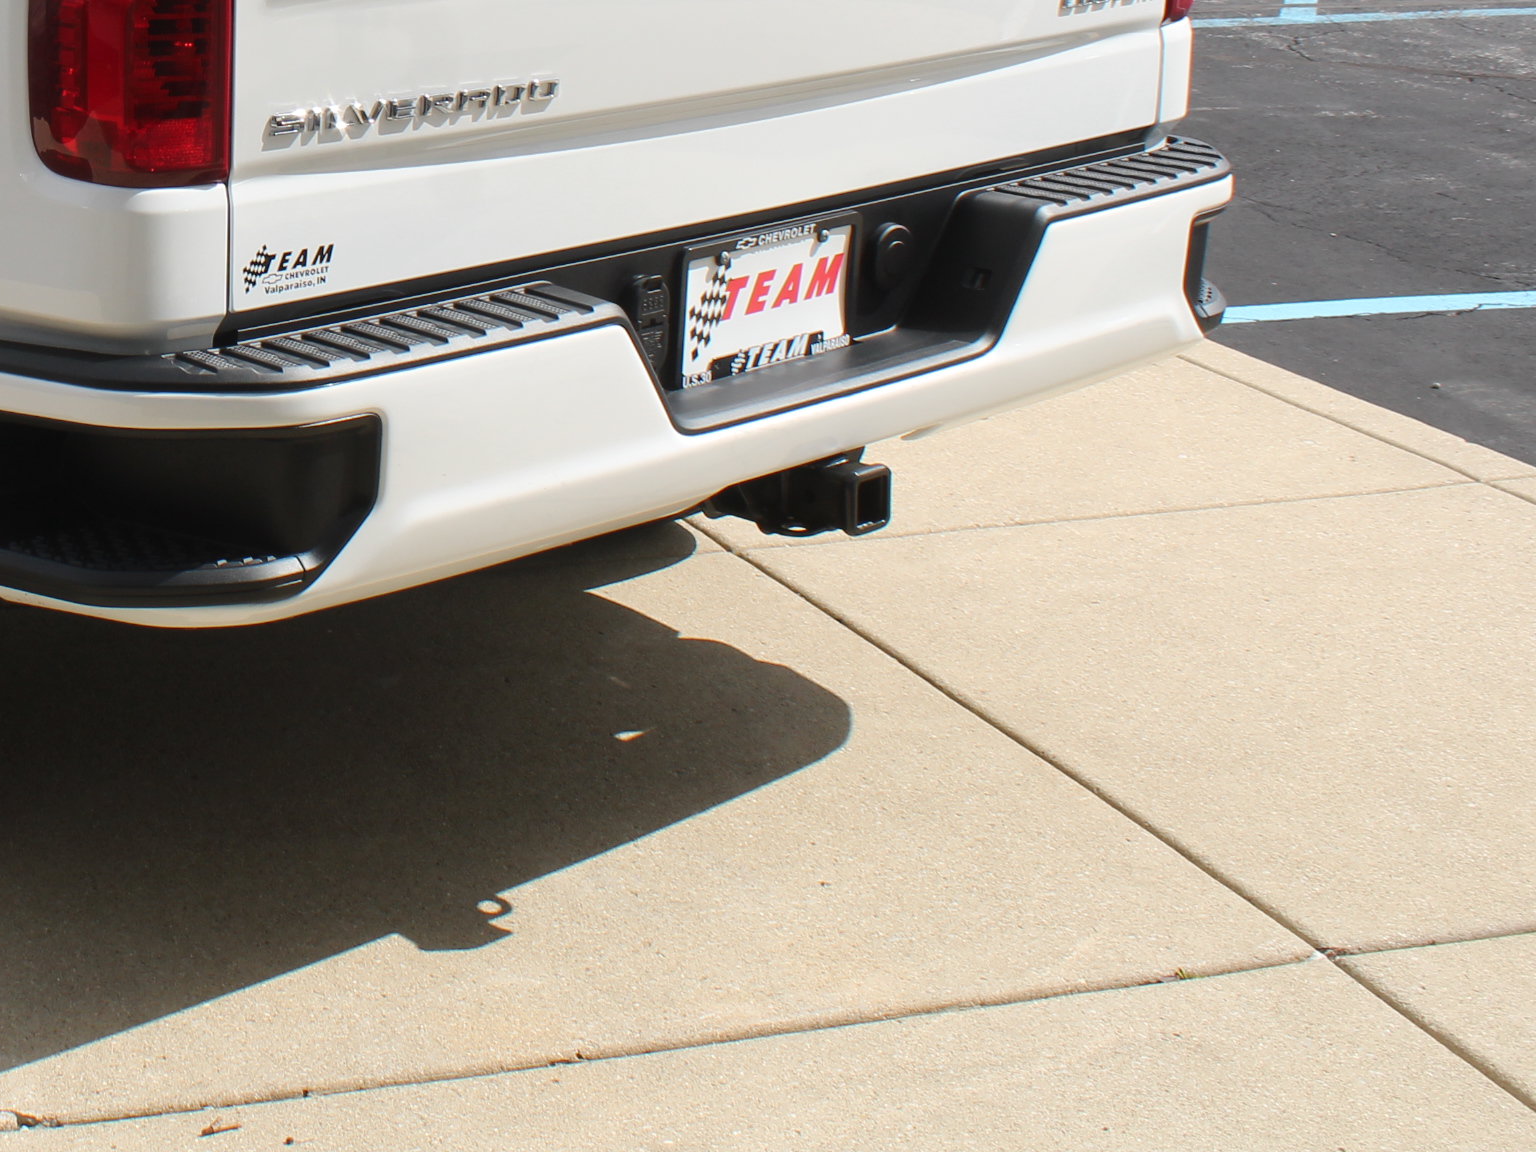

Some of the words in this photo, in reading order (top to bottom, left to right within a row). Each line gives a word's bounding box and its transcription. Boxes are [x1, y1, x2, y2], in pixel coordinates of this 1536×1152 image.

[267, 78, 561, 138] SILVERADO
[757, 223, 817, 247] CHEVROLET
[264, 243, 335, 274] TEAM
[265, 280, 316, 294] Valparaiso,
[316, 276, 327, 285] IN
[284, 266, 329, 281] CHEVROLET
[721, 252, 846, 322] TEAM
[745, 333, 811, 369] TEAM
[810, 334, 852, 356] VALPARAISO
